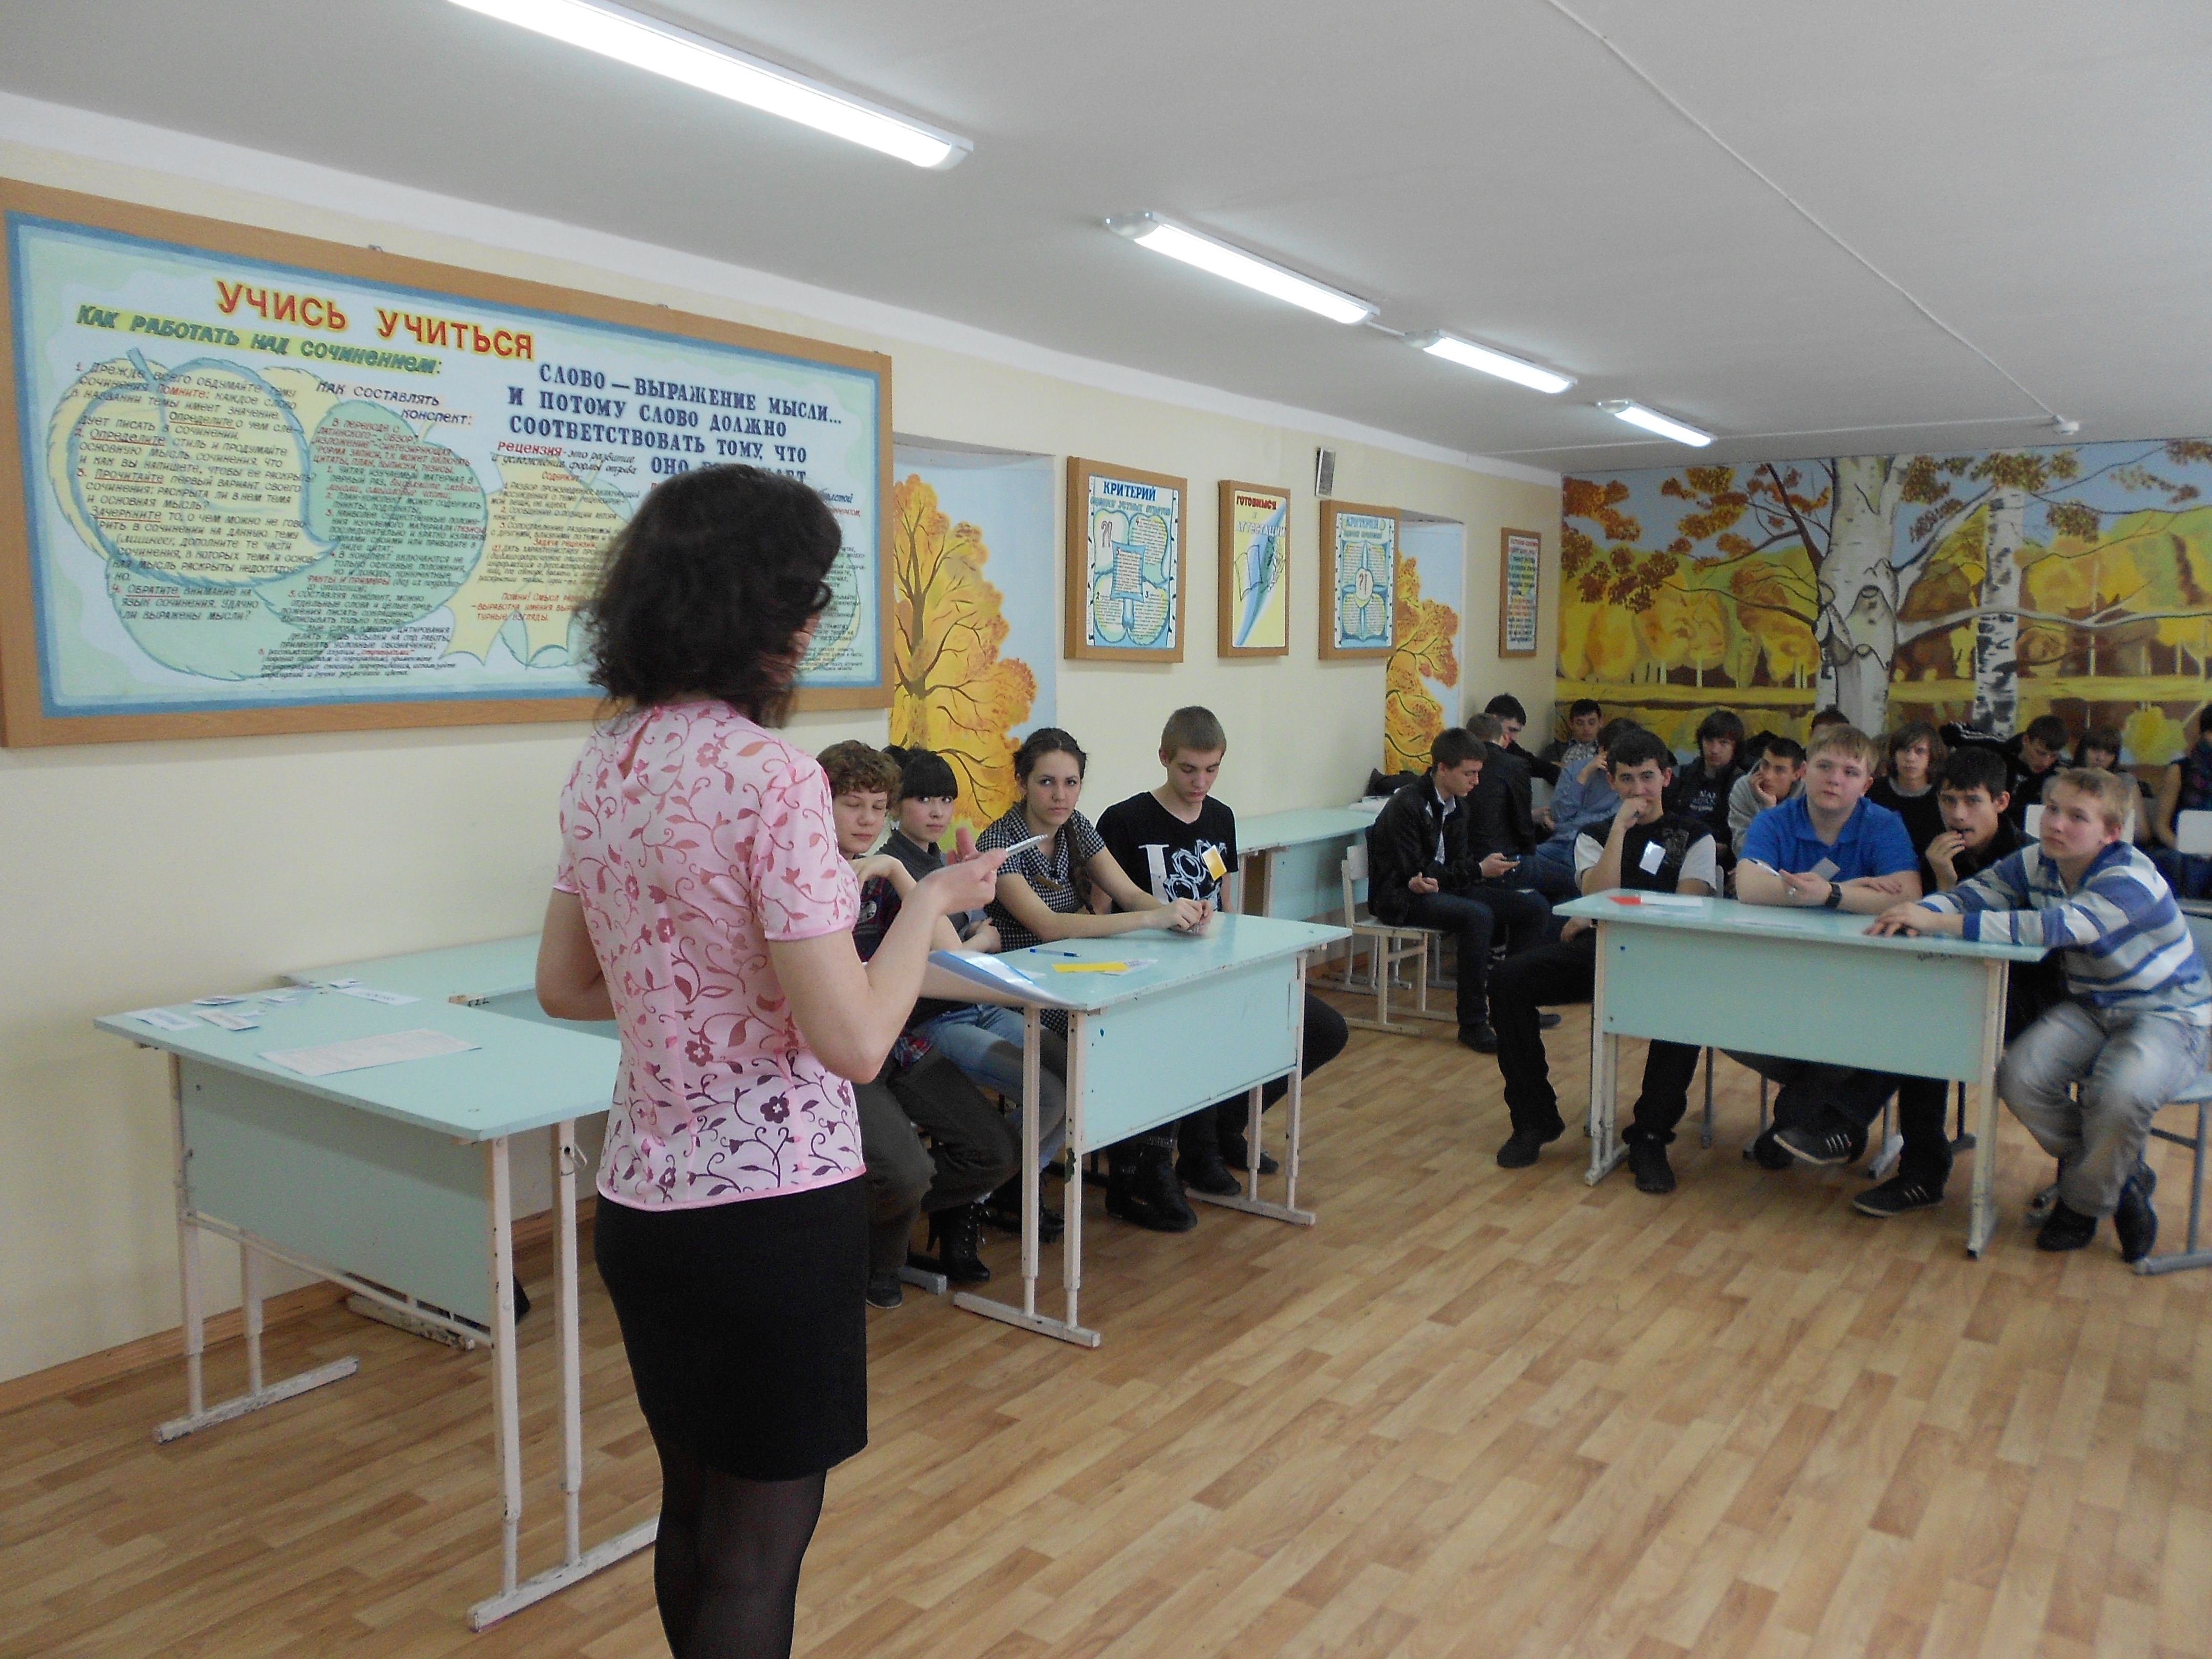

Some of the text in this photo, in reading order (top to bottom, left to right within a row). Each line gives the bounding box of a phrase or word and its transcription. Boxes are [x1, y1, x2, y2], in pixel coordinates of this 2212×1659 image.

[129, 312, 240, 348] РАБОТАТЬ
[250, 332, 290, 356] НАД
[216, 279, 533, 362] УЧИСЬ УЧИТЬСЯ
[353, 385, 439, 406] СОСТАВЛЯТЬ
[539, 363, 605, 391] СЛОВО
[634, 377, 756, 412] ВЫРАЖЕНИЕ
[507, 386, 786, 439] И ПОТОМУ СЛОВО ДОЛЖНО
[509, 414, 806, 463] СООТВЕТСТВОВАТЬ ТОМУ, ЧТО
[650, 455, 688, 477] ОНО
[1237, 495, 1277, 510] ГОТОВИМСЯ
